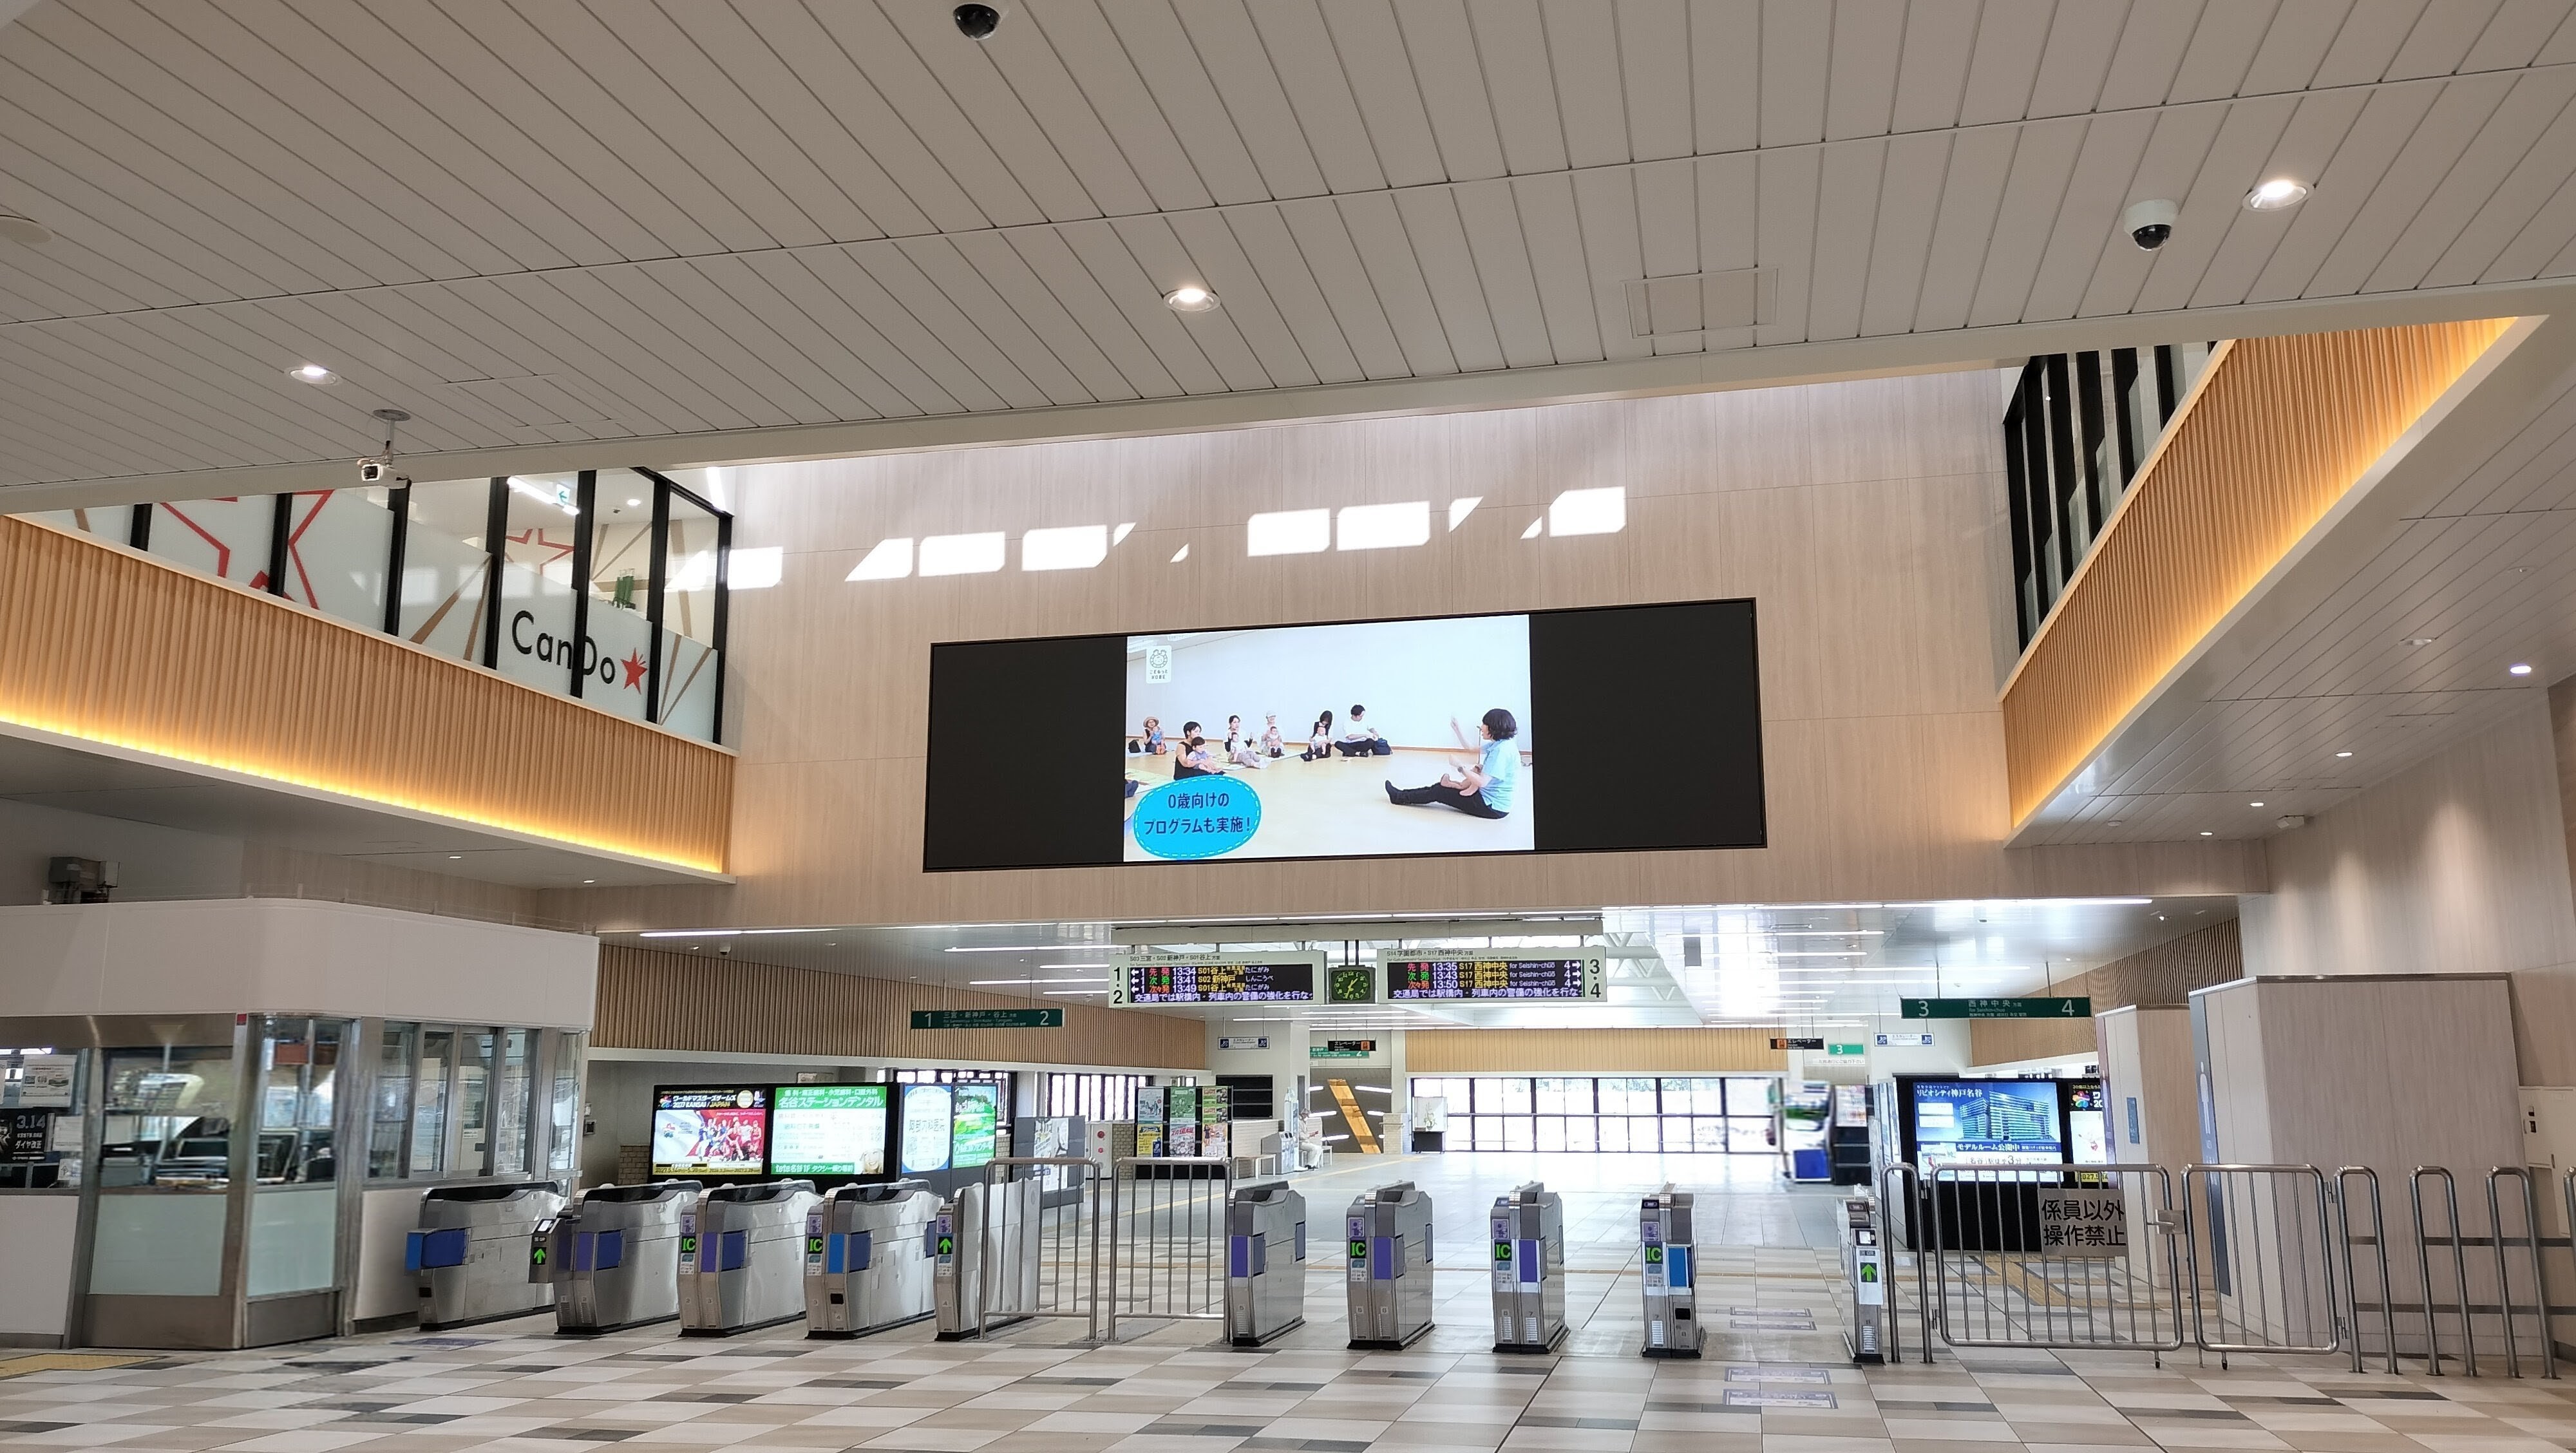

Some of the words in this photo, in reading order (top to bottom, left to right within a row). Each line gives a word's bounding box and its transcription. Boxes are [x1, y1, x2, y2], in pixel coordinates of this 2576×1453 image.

[512, 610, 616, 684] CanDo
[1168, 792, 1229, 809] 0歳向けの
[1141, 967, 1145, 976] 1
[1172, 967, 1197, 976] 13:34
[1432, 962, 1457, 971] 13:35
[1474, 962, 1508, 972] 西神中央
[1564, 960, 1571, 969] 4
[1589, 959, 1600, 974] 3
[1113, 967, 1121, 982] 1
[1141, 976, 1145, 984] 1
[1172, 975, 1196, 984] 13:41
[1432, 971, 1457, 980] 13:43
[1474, 971, 1508, 980] 西神中央
[1564, 970, 1571, 978] 4
[1141, 985, 1145, 993] 1
[1172, 983, 1197, 993] 13:49
[1433, 980, 1458, 989] 13:50
[1474, 980, 1508, 989] 西神中央
[1564, 979, 1571, 987] 4
[1590, 983, 1601, 998] 4
[1113, 989, 1123, 1004] 2
[1918, 1000, 1929, 1017] 3
[2061, 999, 2075, 1016] 4
[924, 1012, 932, 1027] 1
[1039, 1011, 1050, 1025] 2
[1836, 1045, 1844, 1054] 3
[778, 1096, 884, 1108] 名谷ステーションデンタル
[16, 1114, 46, 1129] 3.14
[15, 1139, 43, 1149] ダイヤ改正
[1956, 1143, 2020, 1152] モデルルーム公開中
[2041, 1199, 2125, 1221] 係員以外
[2043, 1224, 2126, 1247] 操作禁止
[681, 1238, 696, 1251] IC
[808, 1239, 823, 1252] IC
[1351, 1242, 1366, 1256] IC
[1495, 1244, 1511, 1259] IC
[1646, 1247, 1662, 1262] IC
